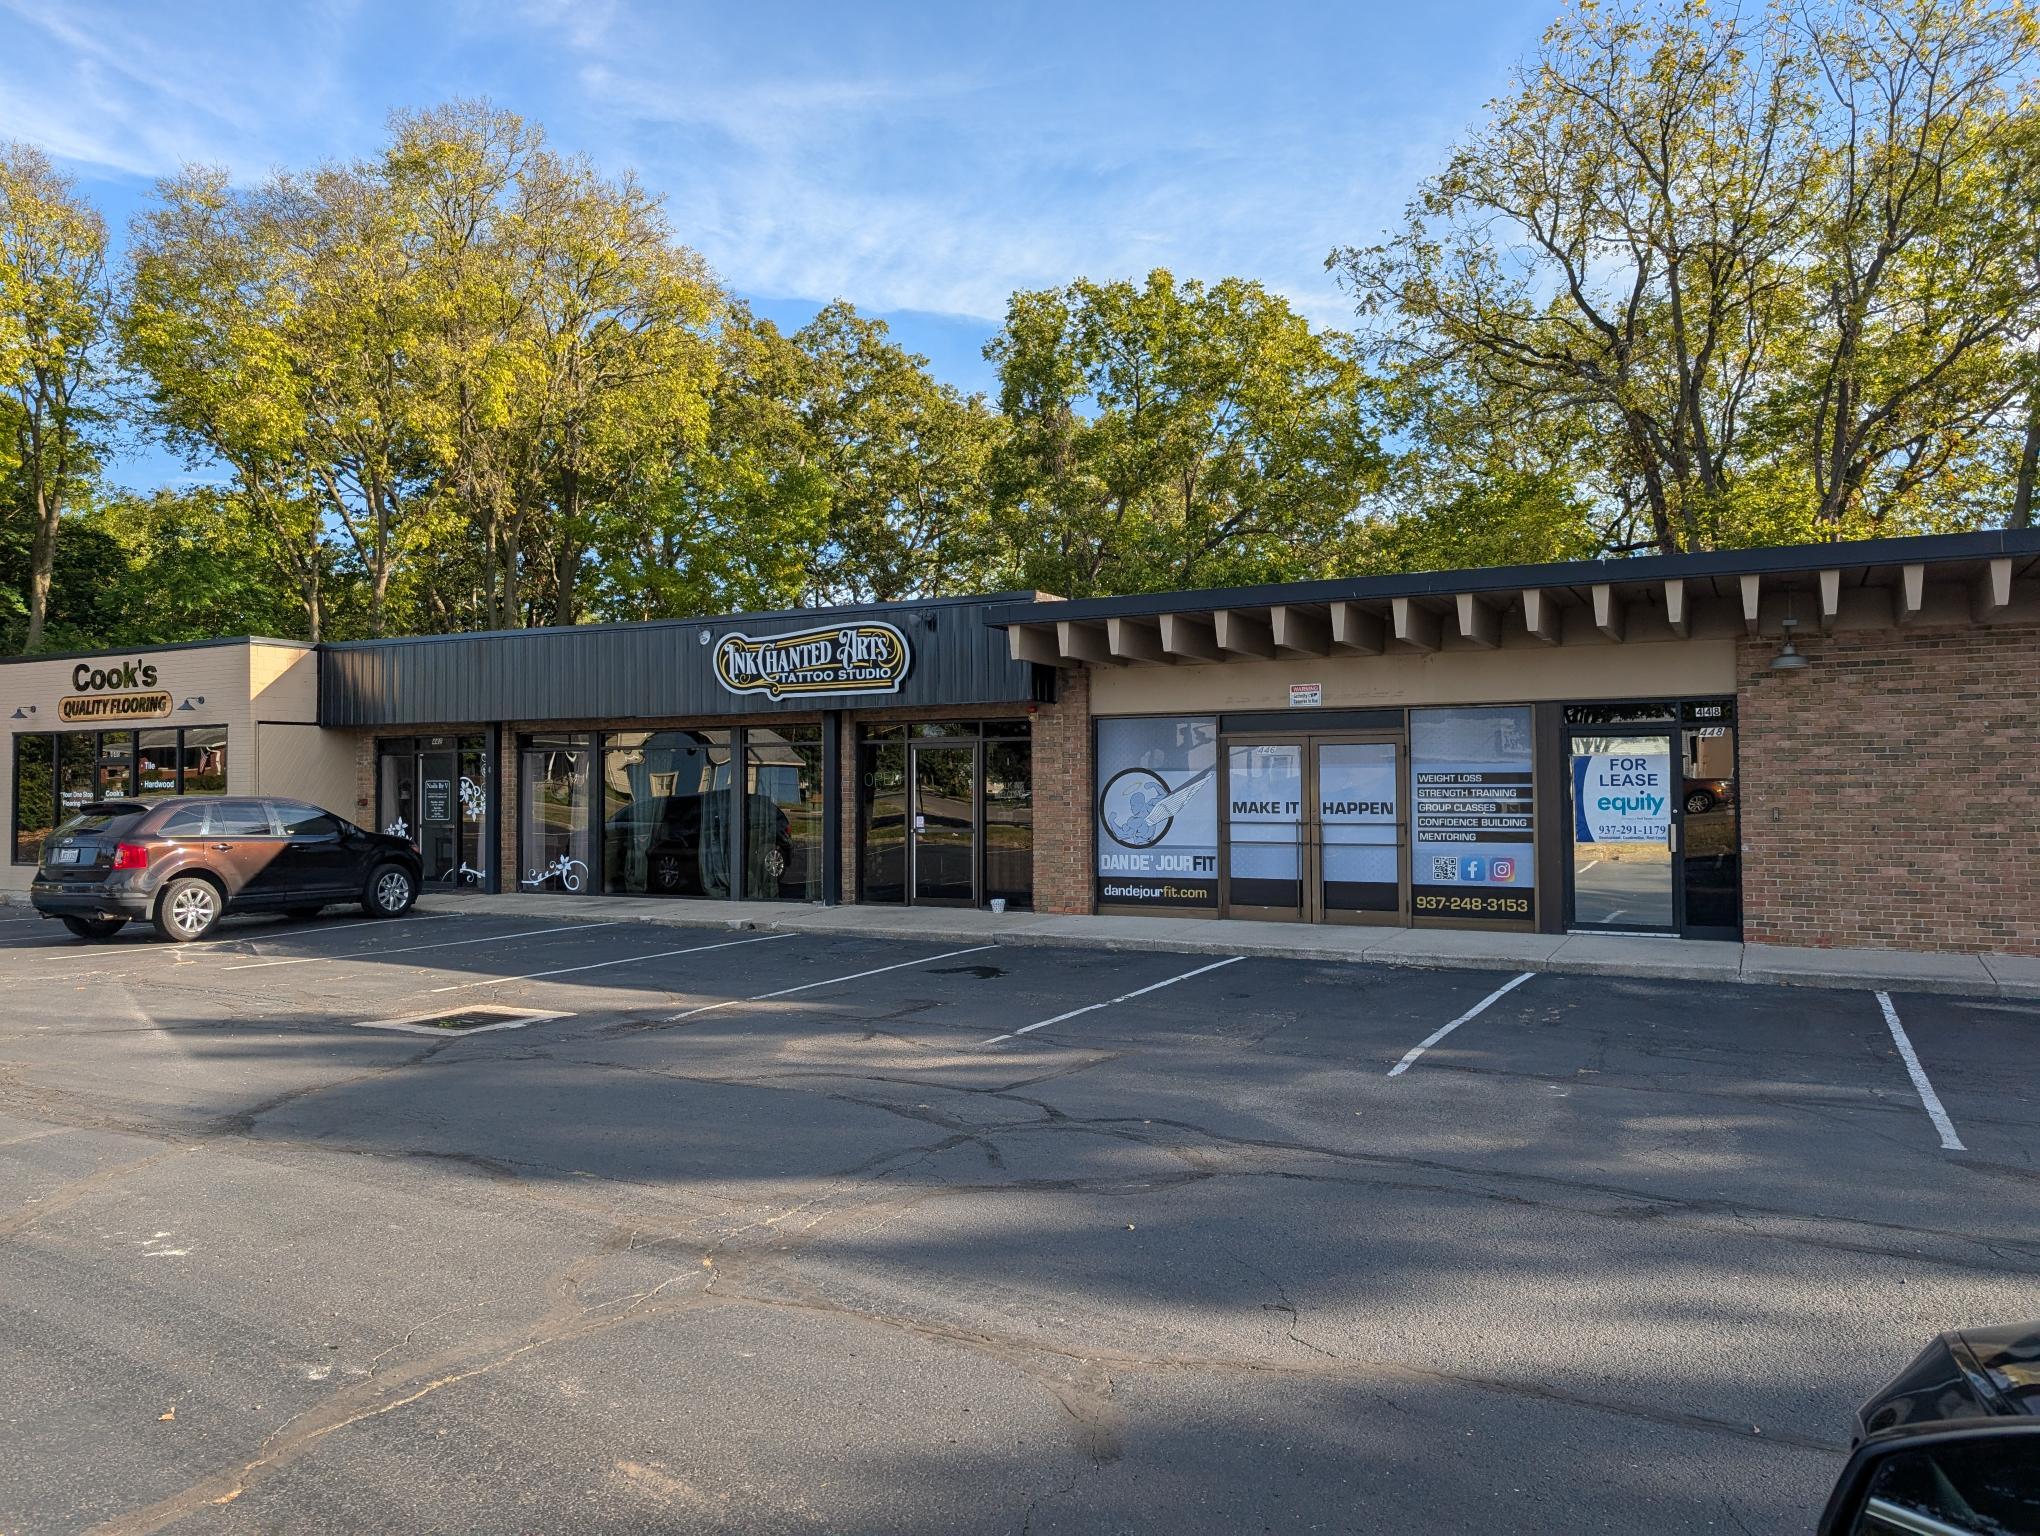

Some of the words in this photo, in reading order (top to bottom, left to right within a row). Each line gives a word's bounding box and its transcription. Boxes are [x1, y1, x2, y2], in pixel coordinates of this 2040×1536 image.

[837, 629, 888, 669] ARTS
[72, 659, 158, 692] Cook's
[779, 672, 834, 683] TATTOO
[838, 667, 891, 680] STUDIO
[64, 699, 110, 718] QUALITY
[110, 695, 167, 714] FLOORING
[1696, 707, 1721, 716] 448
[1700, 728, 1723, 736] 448
[1609, 758, 1647, 771] FOR
[1418, 774, 1455, 783] WEIGHT
[1457, 774, 1482, 782] LOSS
[1599, 774, 1658, 787] LEASE
[1418, 789, 1468, 797] STRENGTH
[1470, 789, 1517, 797] TRAINING
[1232, 801, 1281, 814] MAKE
[1285, 801, 1299, 814] IT
[1322, 802, 1394, 815] HAPPEN
[1418, 803, 1451, 812] GROUP
[1453, 803, 1496, 812] CLASSES
[1597, 790, 1664, 816] equity
[1419, 818, 1479, 826] CONFIDENCE
[1481, 818, 1527, 827] BUILDING
[1419, 832, 1476, 841] MENTORING
[1598, 825, 1666, 835] 937-291-1179
[1104, 884, 1207, 899] dandejourfit.com
[1416, 896, 1528, 912] 937-248-3153
